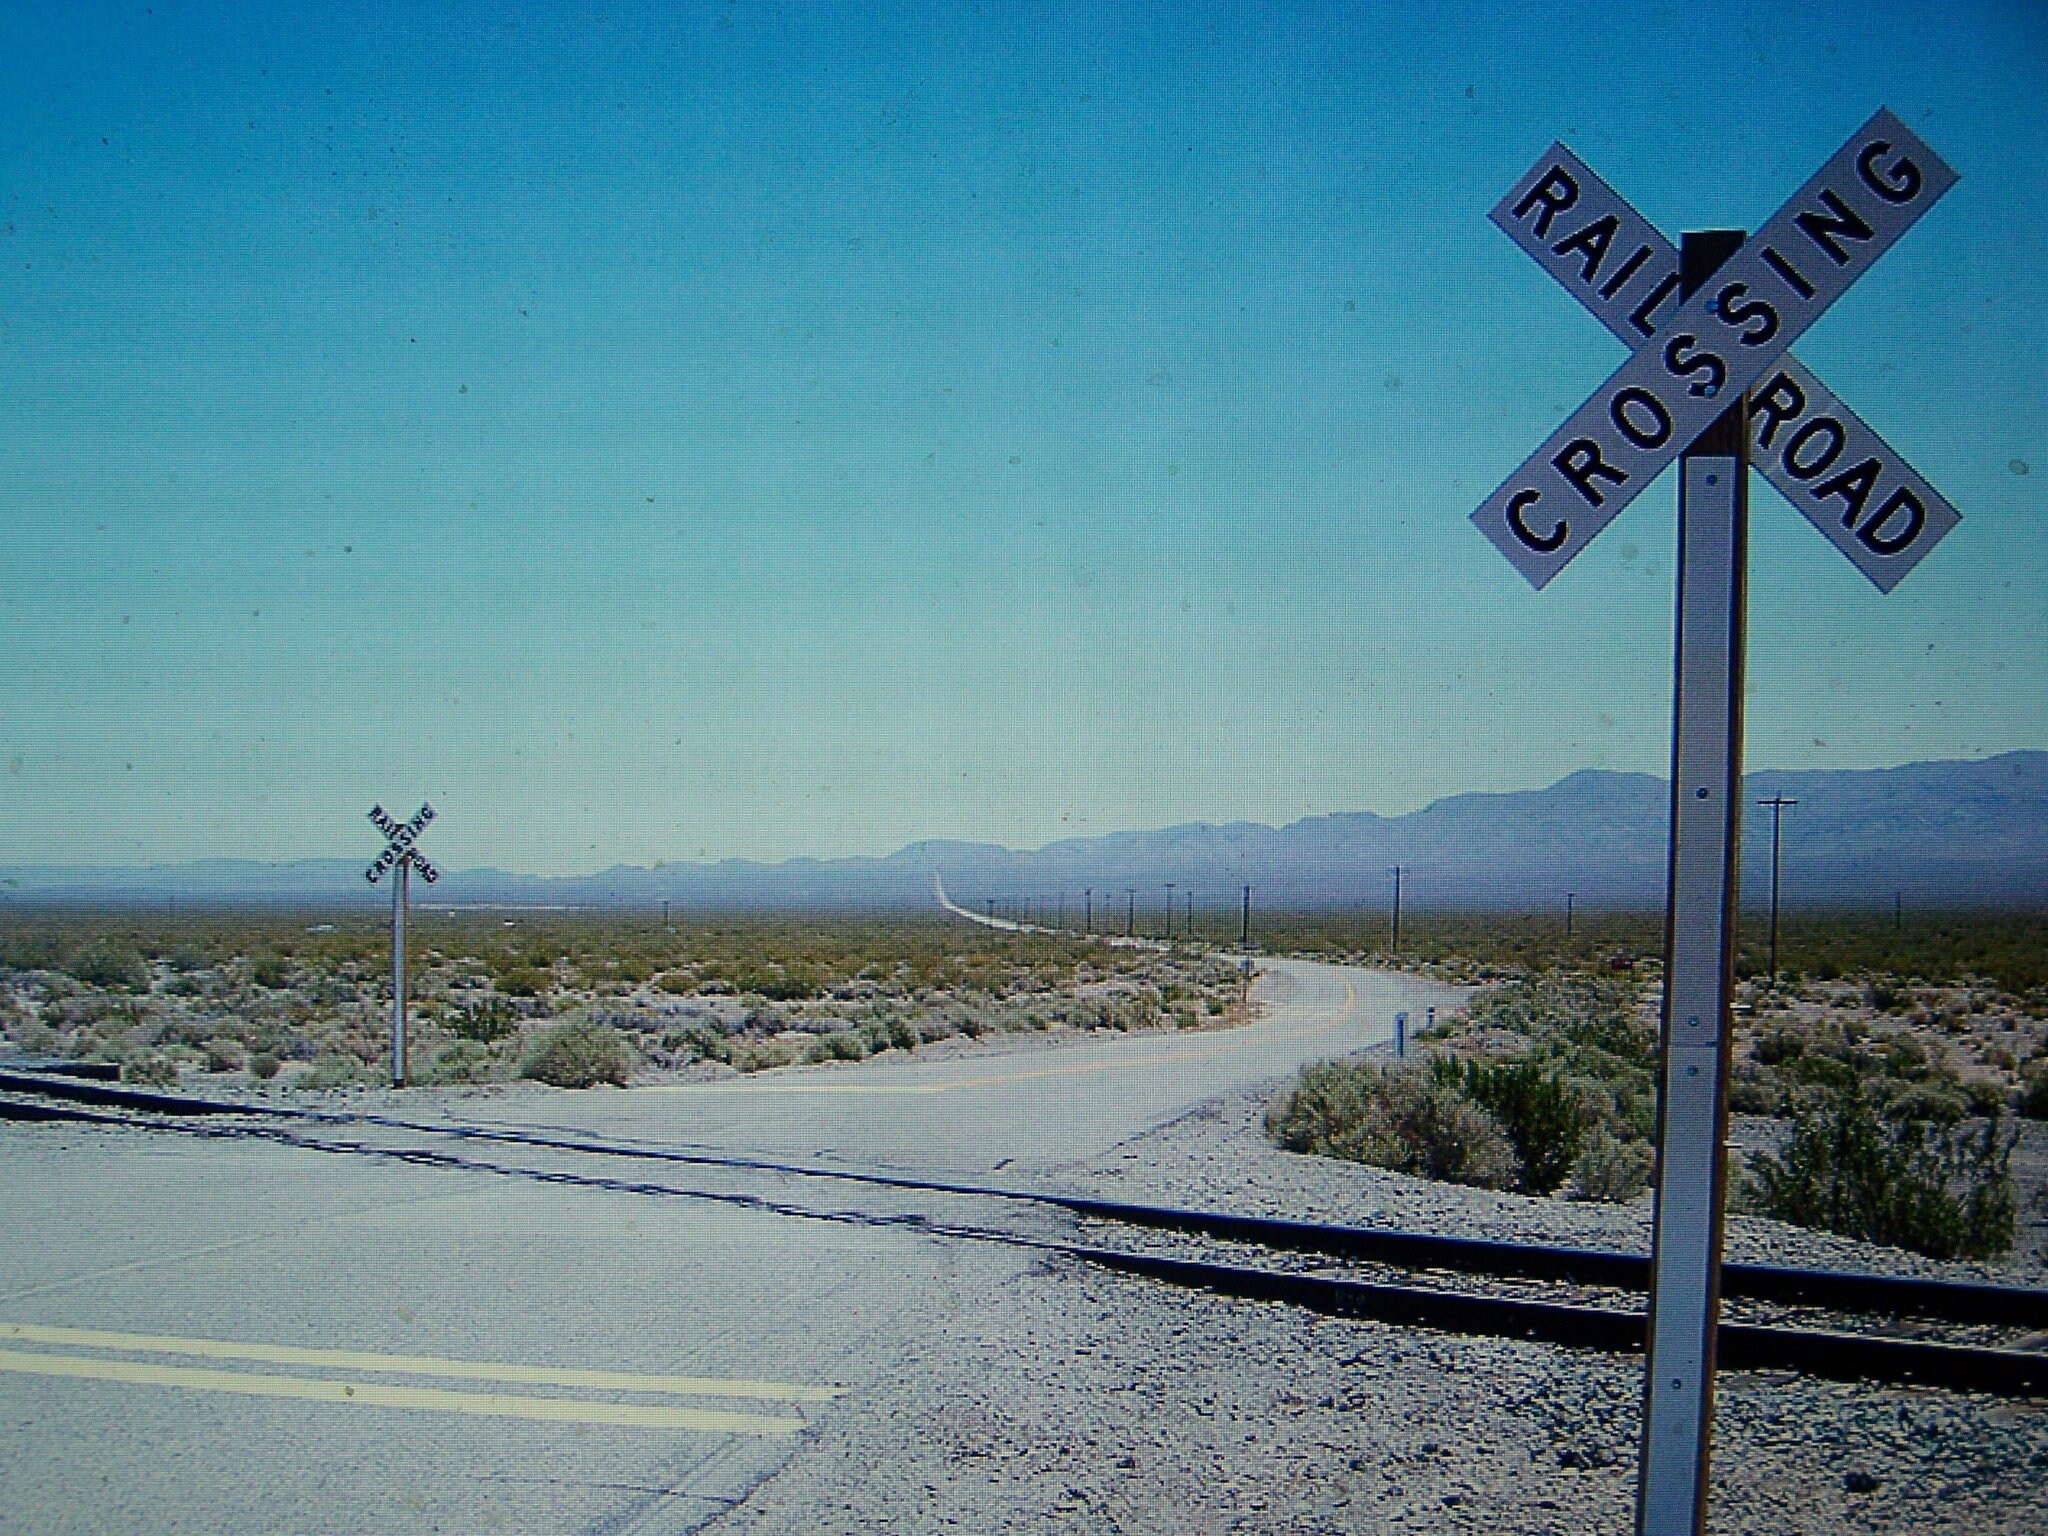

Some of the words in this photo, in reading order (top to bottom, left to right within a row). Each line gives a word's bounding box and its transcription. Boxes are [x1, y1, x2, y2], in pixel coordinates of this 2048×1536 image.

[1512, 165, 1681, 338] RAIL
[1505, 140, 1922, 553] CROSSING
[1747, 371, 1926, 556] ROAD
[365, 807, 434, 883] CROSSING
